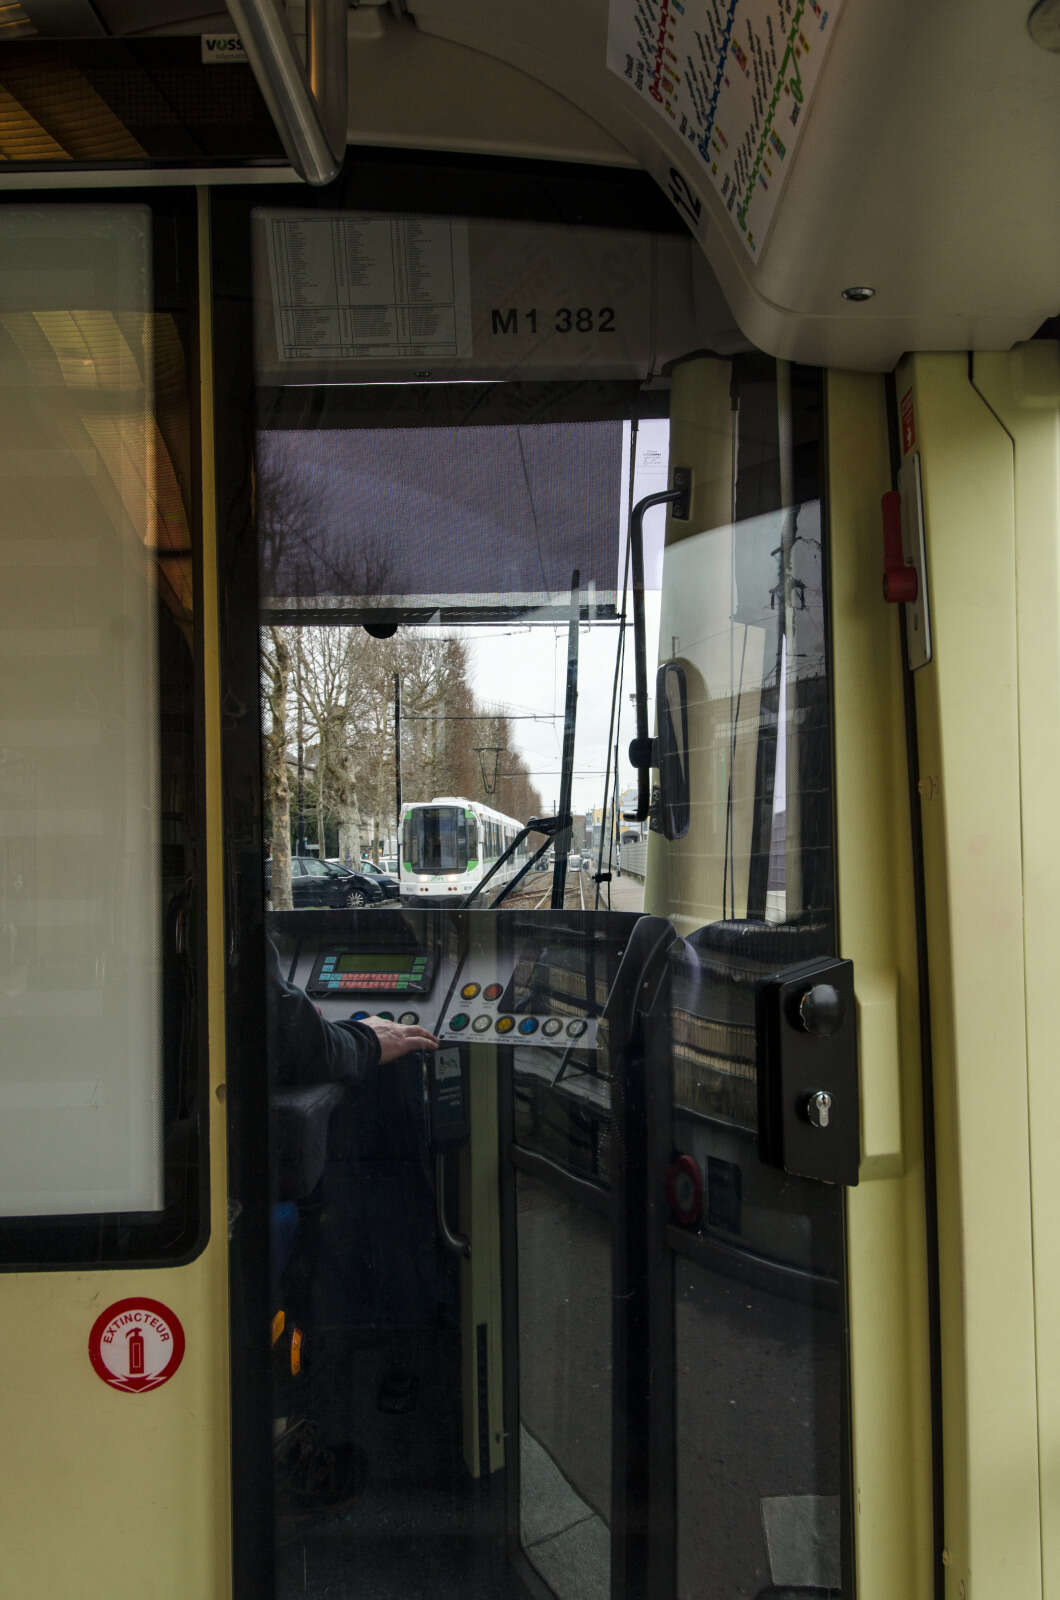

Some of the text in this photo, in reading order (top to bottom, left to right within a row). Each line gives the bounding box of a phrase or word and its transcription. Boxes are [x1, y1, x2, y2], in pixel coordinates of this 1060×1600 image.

[491, 307, 616, 334] M1 382
[103, 1312, 170, 1344] EXTINCTEUR
